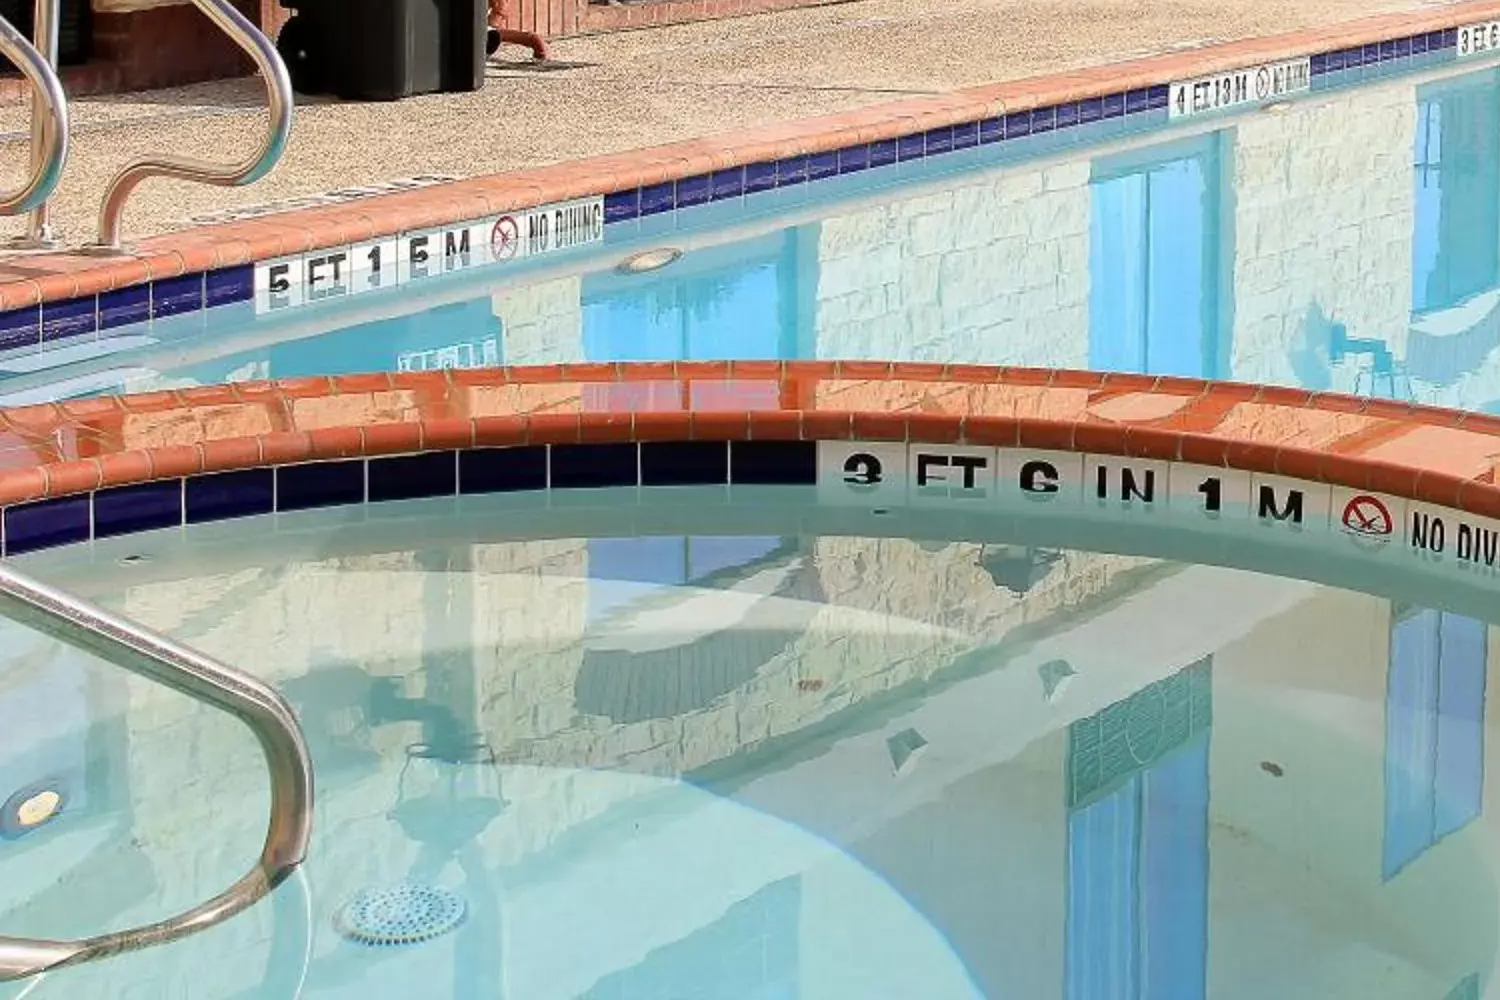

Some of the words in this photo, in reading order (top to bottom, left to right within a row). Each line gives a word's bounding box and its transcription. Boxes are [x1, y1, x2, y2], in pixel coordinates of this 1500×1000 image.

[269, 264, 290, 293] 5
[308, 253, 347, 285] FT
[445, 229, 470, 257] M
[844, 453, 882, 484] 3
[917, 454, 987, 488] FT
[1097, 465, 1155, 502] IN
[1198, 477, 1221, 510] 1
[1259, 485, 1303, 522] M
[1412, 511, 1445, 553] NO
